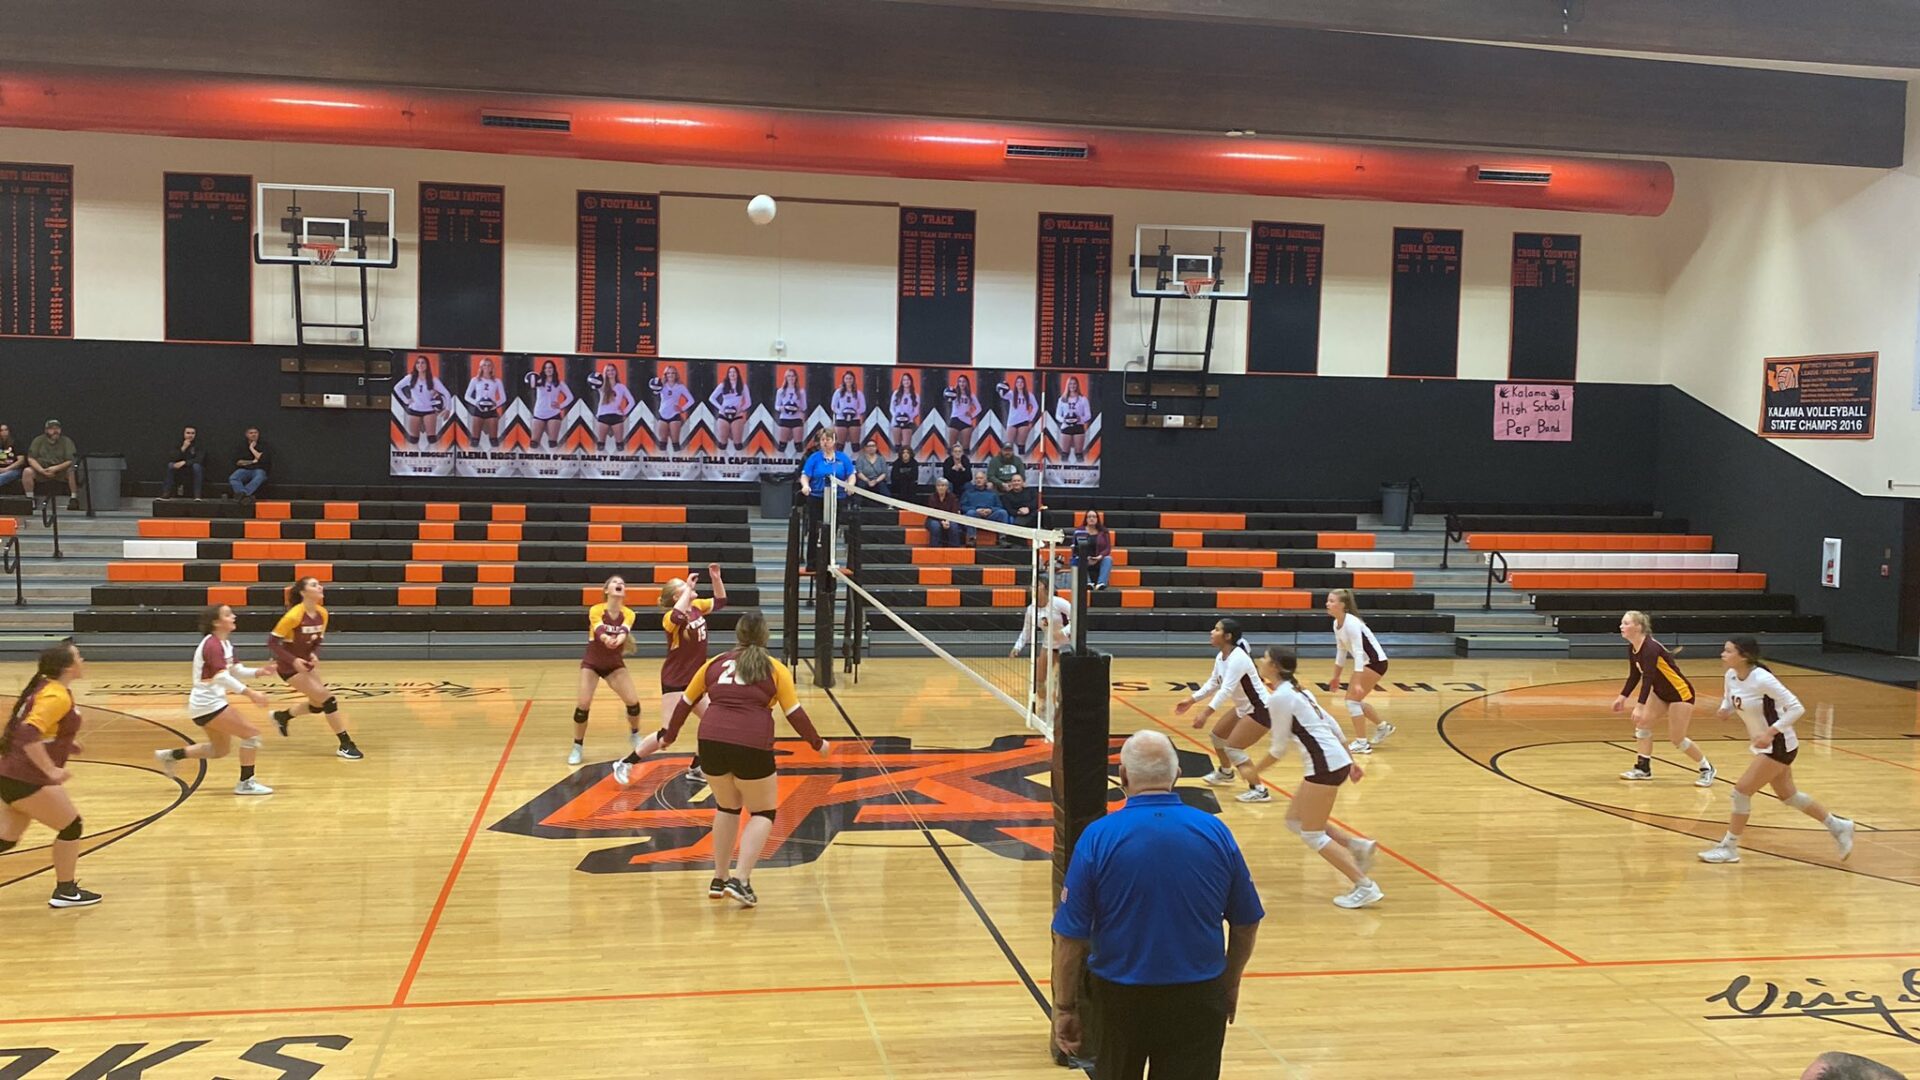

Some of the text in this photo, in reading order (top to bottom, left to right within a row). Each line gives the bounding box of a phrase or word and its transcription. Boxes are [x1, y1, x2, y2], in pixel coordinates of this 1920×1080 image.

[193, 192, 247, 202] BASKETBALL
[601, 199, 653, 210] FOOTBALL
[922, 214, 954, 225] TRACK
[1056, 220, 1110, 231] VOLLEYBALL
[1512, 386, 1547, 398] Kalama
[1501, 400, 1566, 415] High School
[1768, 406, 1867, 417] KALAMA VOLLEYBALL
[1506, 418, 1560, 437] Pep Band
[1771, 420, 1862, 431] STATE CHAMPS 2016
[490, 452, 516, 460] ROSS
[702, 456, 725, 464] ELLA
[697, 625, 707, 642] 15
[1731, 695, 1743, 711] 12
